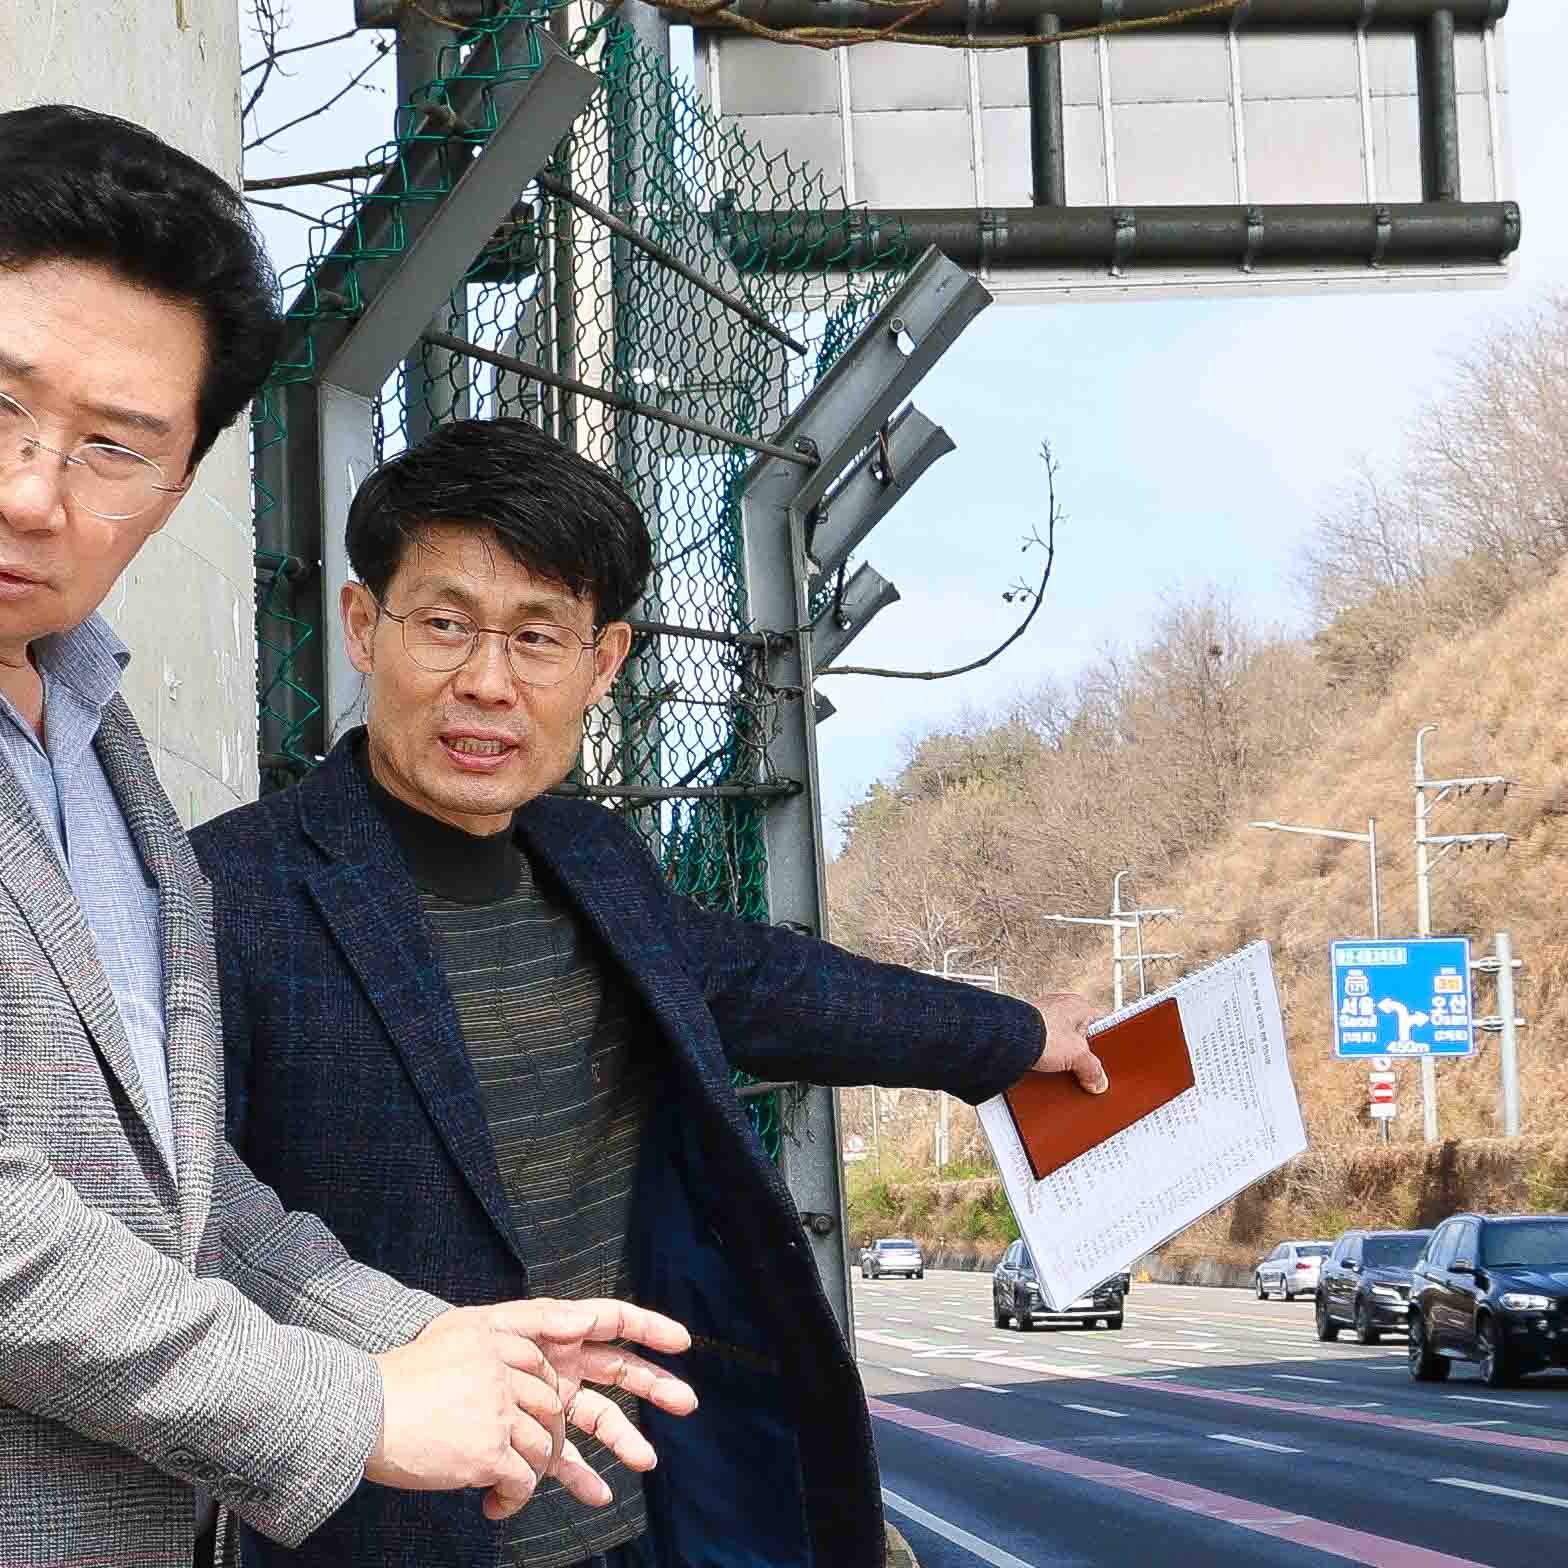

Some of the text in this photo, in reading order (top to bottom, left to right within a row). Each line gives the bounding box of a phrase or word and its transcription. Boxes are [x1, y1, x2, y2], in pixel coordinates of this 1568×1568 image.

[1341, 996, 1375, 1016] 서울
[1432, 995, 1466, 1014] 오산
[1431, 1014, 1467, 1025] Osan
